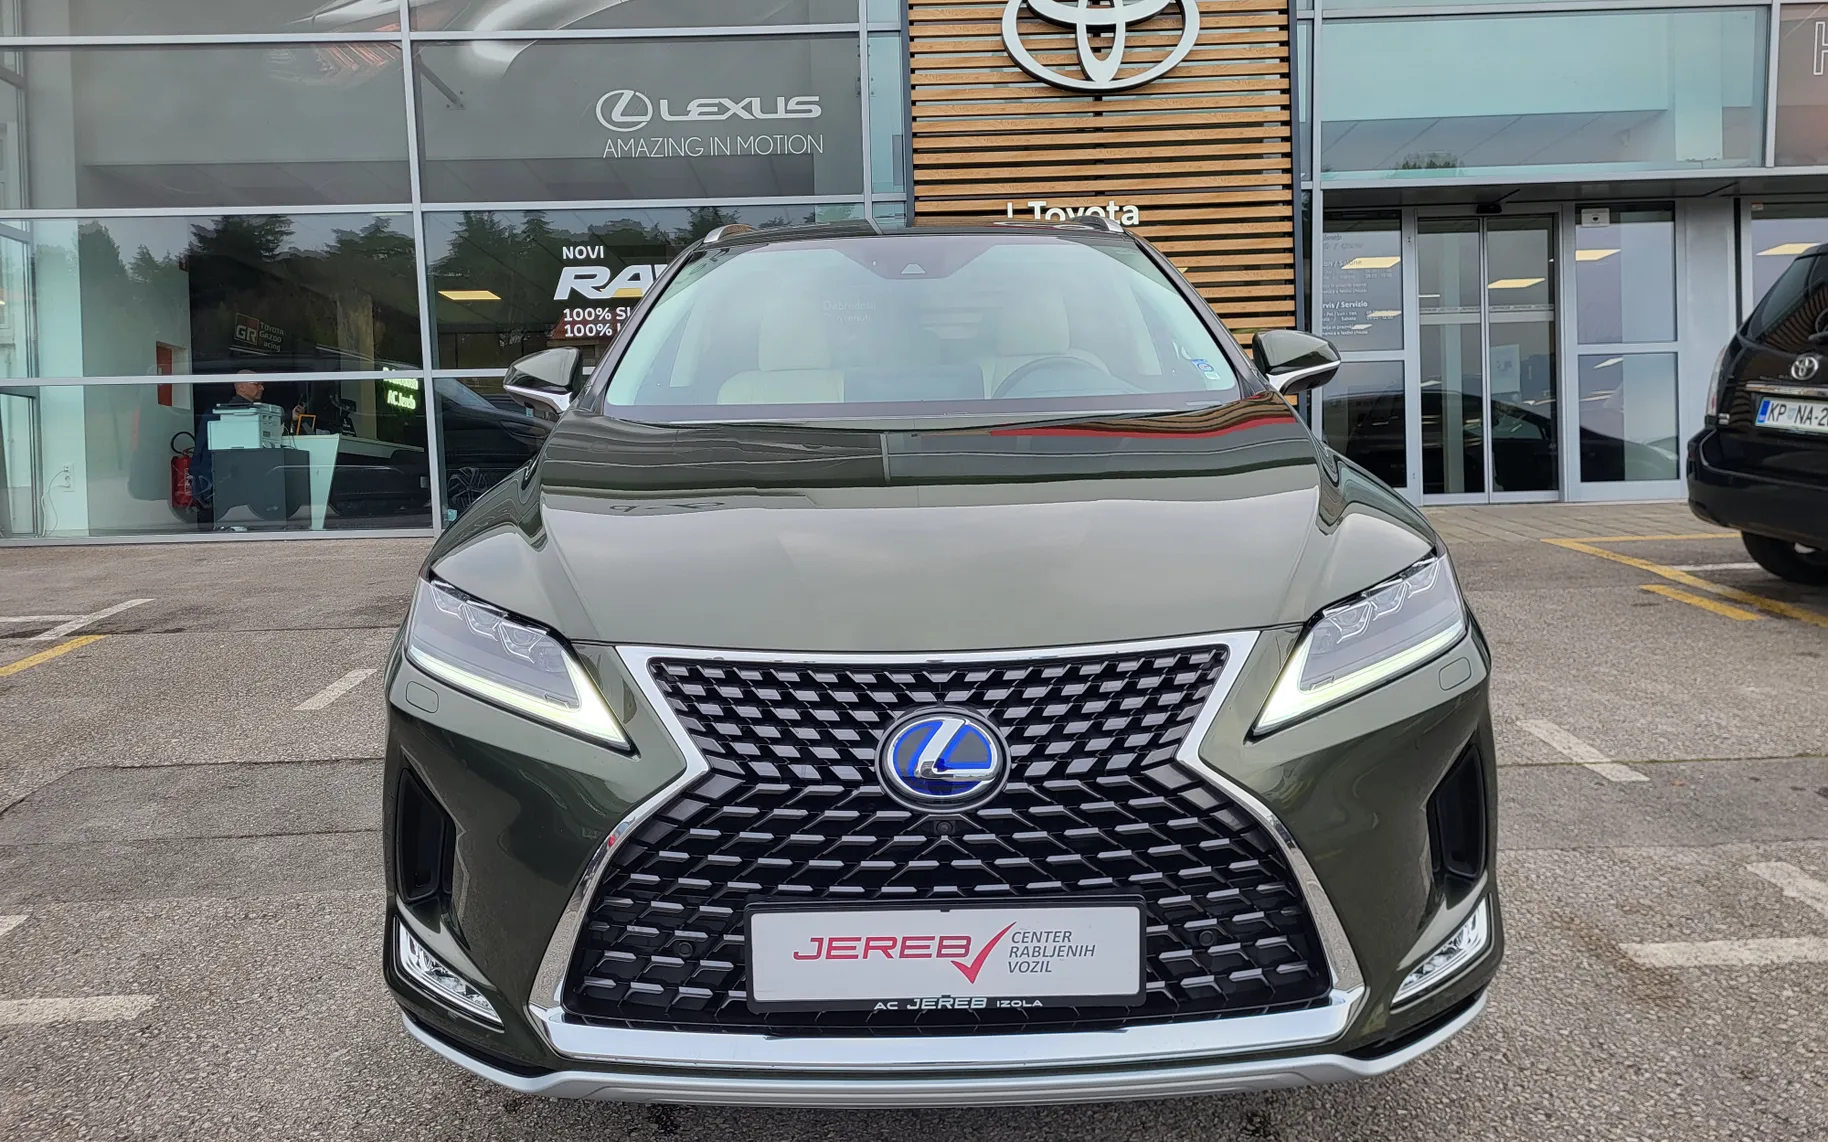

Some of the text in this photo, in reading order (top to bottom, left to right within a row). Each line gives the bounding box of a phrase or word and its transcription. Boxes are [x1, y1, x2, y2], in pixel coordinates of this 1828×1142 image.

[660, 95, 822, 122] LEXUS
[603, 134, 823, 159] AMAZING IN MOTION
[562, 245, 605, 259] NOVI
[1341, 300, 1368, 309] Servizio
[563, 307, 612, 321] 100%
[564, 323, 613, 337] 100%
[263, 341, 281, 352] acing
[1767, 402, 1828, 427] KP NA-2
[1011, 930, 1072, 944] CENTER
[793, 935, 972, 960] JEREB
[1008, 945, 1096, 959] RABLJENIH
[1007, 961, 1053, 974] VOZIL
[874, 997, 1043, 1011] AC JEREB IZOLA
